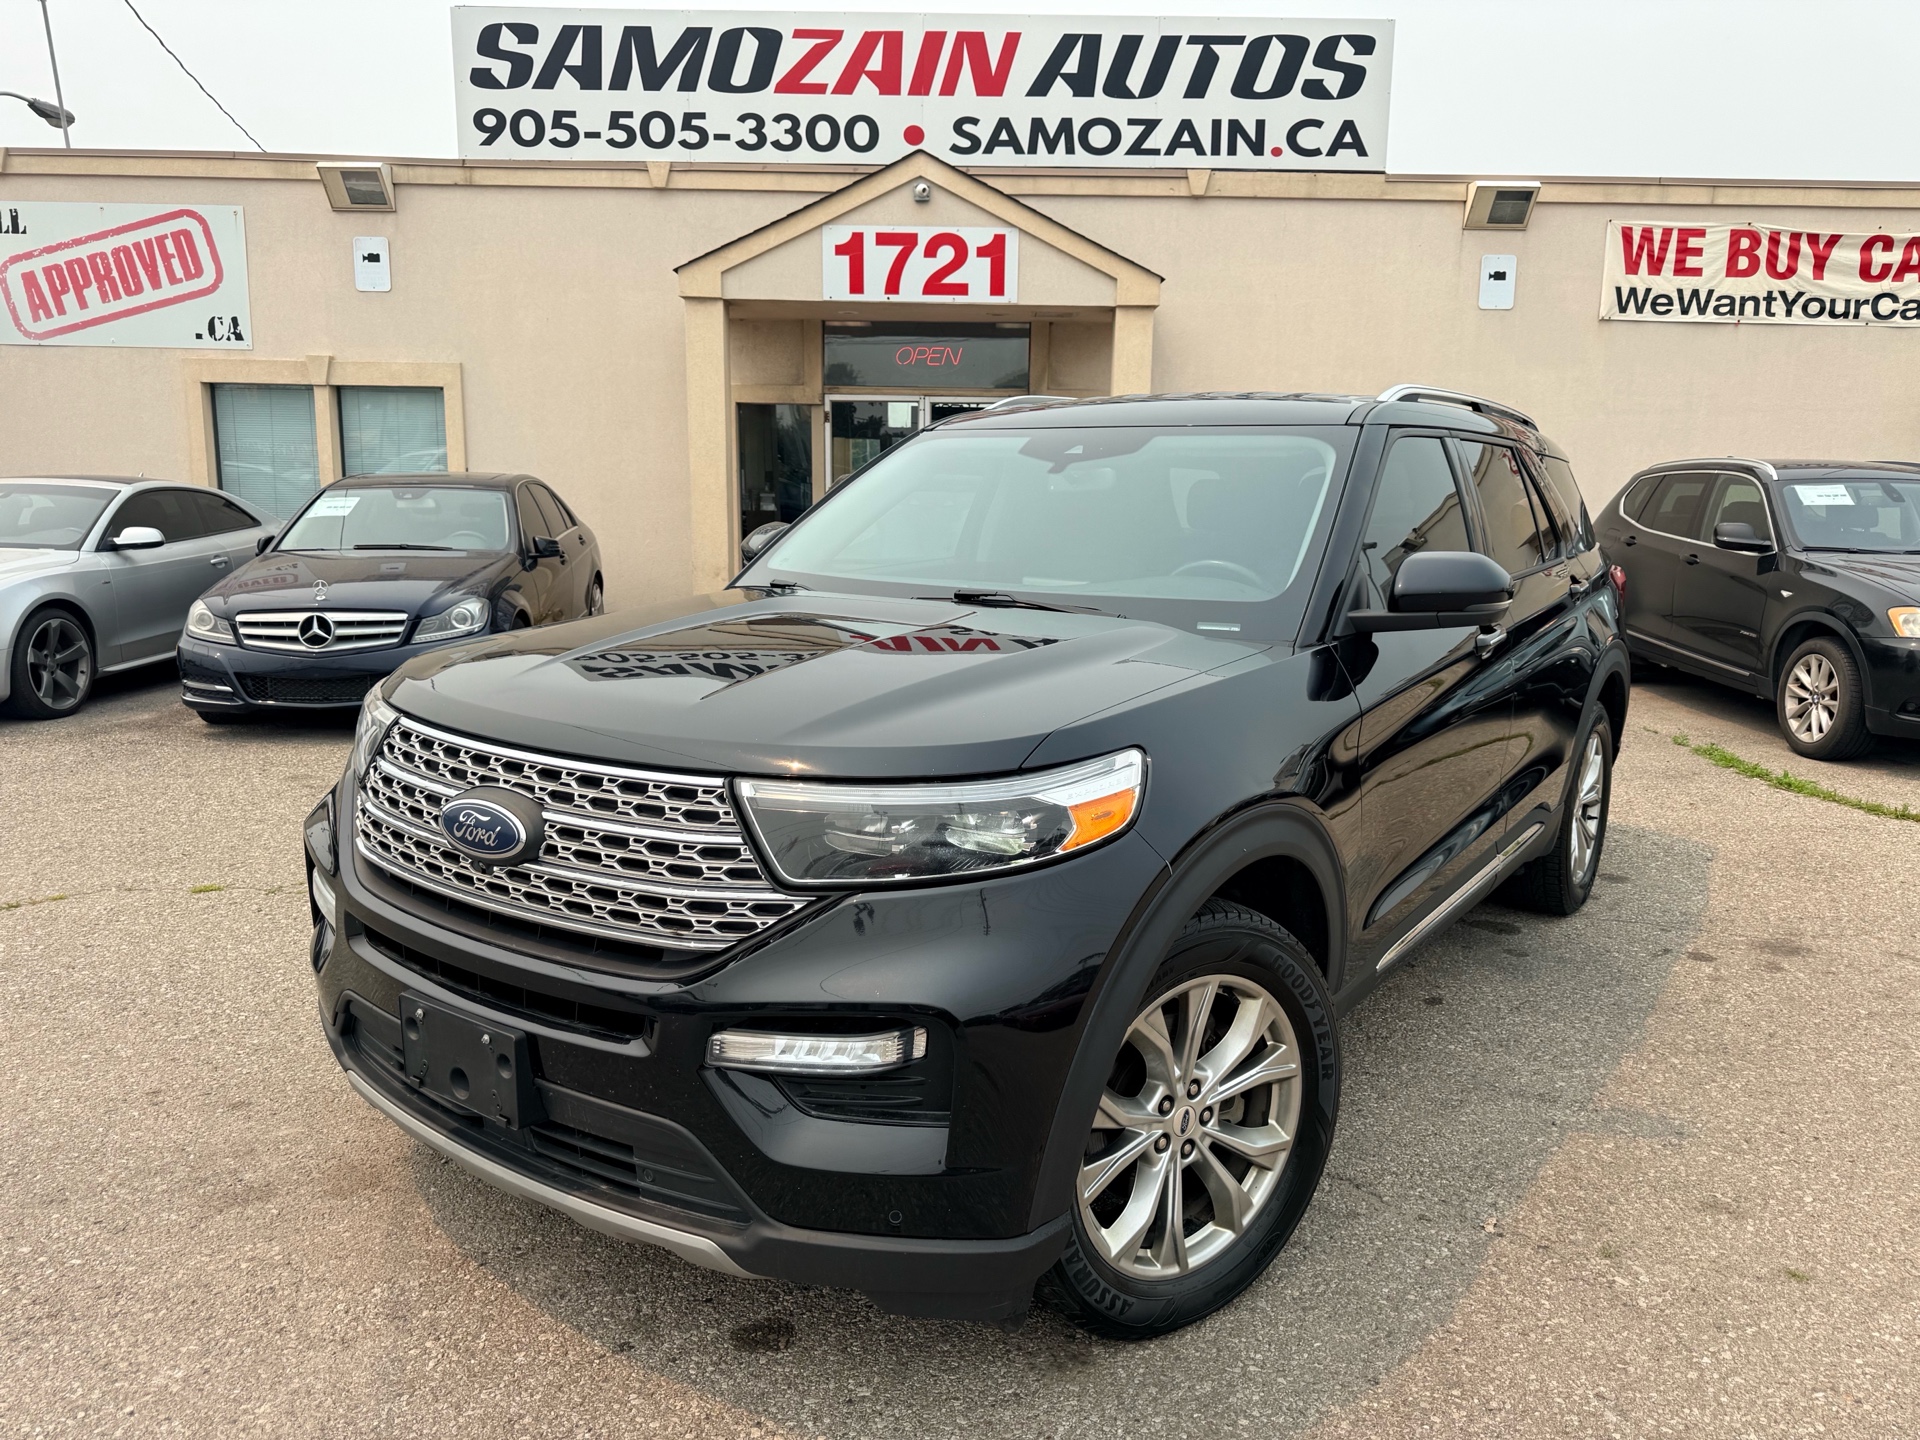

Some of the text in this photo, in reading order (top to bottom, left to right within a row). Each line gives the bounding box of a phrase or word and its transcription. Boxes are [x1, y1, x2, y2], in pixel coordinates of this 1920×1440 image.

[470, 23, 1377, 100] SAMOZAIN AUTOS
[473, 107, 1369, 158] 905-505-3300 SAMOZAIN.CA
[20, 228, 205, 324] APPROVED
[833, 231, 1007, 297] 1721
[1621, 225, 1707, 277] WE
[1725, 228, 1844, 281] BUY
[1615, 286, 1920, 321] WeWantYourCa
[895, 346, 963, 366] OPEN
[453, 809, 502, 847] Ford
[1270, 954, 1335, 1083] GOODYEAR
